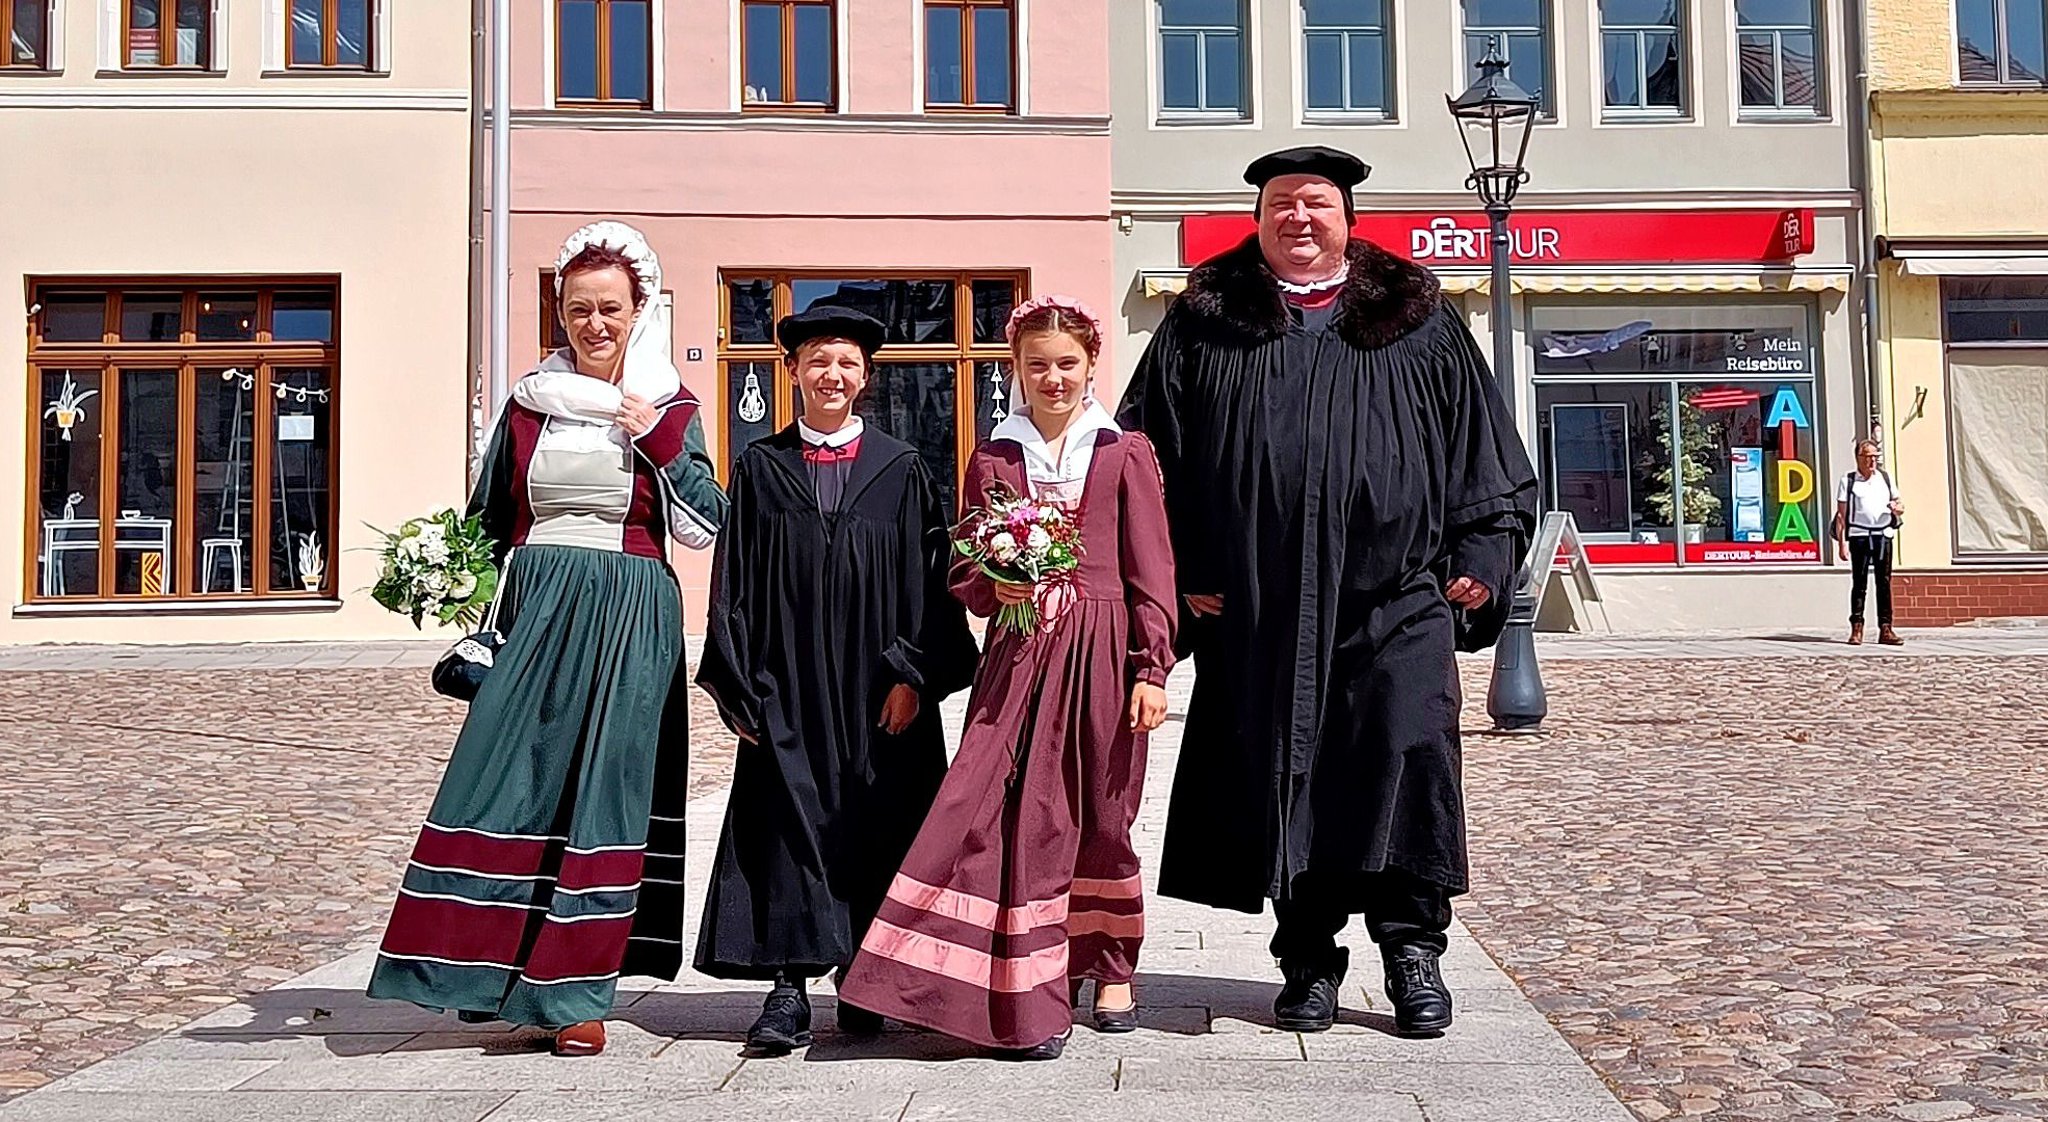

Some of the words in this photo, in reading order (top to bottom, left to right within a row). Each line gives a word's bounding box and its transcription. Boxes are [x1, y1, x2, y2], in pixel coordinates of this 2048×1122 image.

[1411, 226, 1560, 258] DERTUR
[1763, 337, 1802, 352] Mein
[1726, 356, 1803, 371] Reisebüro
[1766, 386, 1814, 543] AIDA
